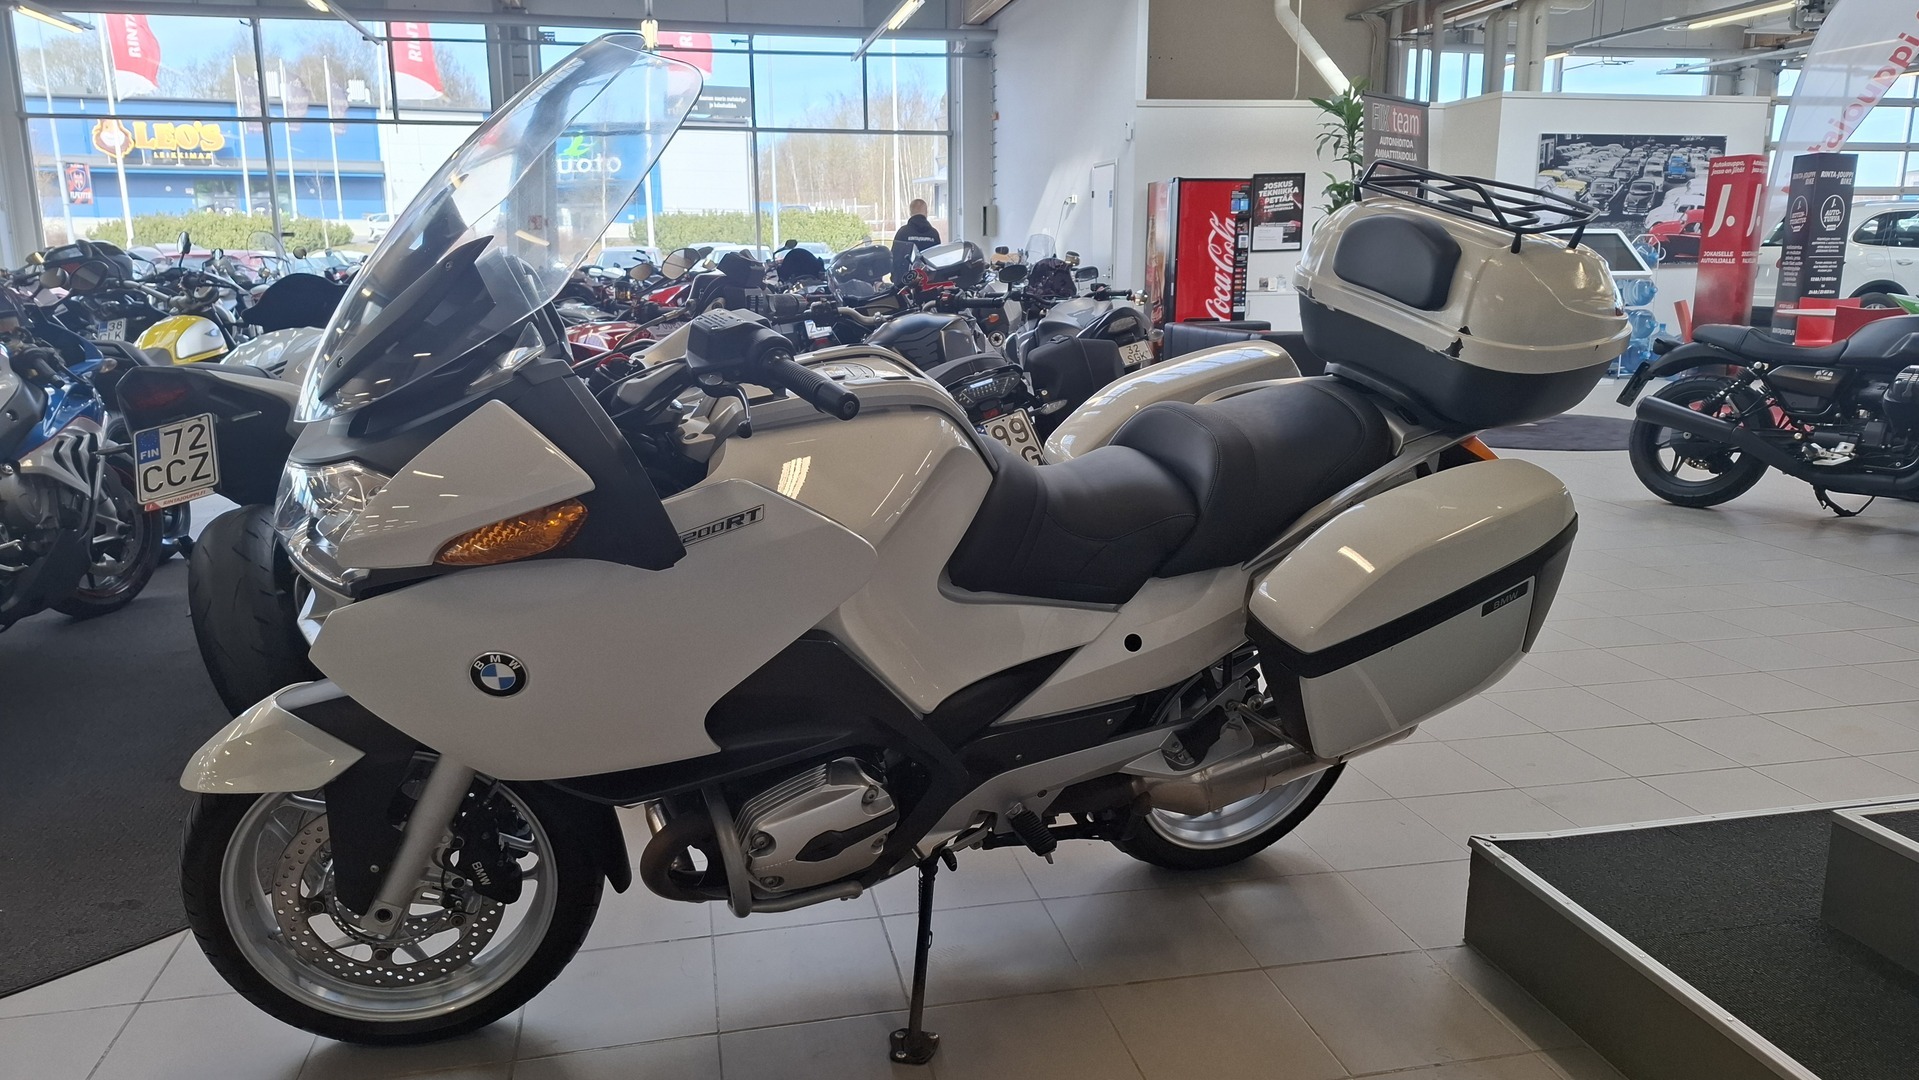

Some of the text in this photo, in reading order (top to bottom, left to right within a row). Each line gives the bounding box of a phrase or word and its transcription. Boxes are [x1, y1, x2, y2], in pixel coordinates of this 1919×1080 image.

[1372, 103, 1420, 135] FIX team
[132, 121, 225, 151] LEO'S
[1259, 186, 1299, 198] TEKNIIKKA
[1264, 180, 1293, 190] JOSKUS
[109, 321, 122, 331] 38
[1127, 344, 1140, 354] 32
[164, 424, 207, 455] 72
[991, 418, 1029, 446] 99
[140, 448, 160, 460] FIN
[143, 452, 211, 492] CCZ
[680, 507, 761, 544] 200RT
[1493, 590, 1519, 609] BMW
[473, 655, 521, 670] BMW
[472, 861, 491, 885] BMW
